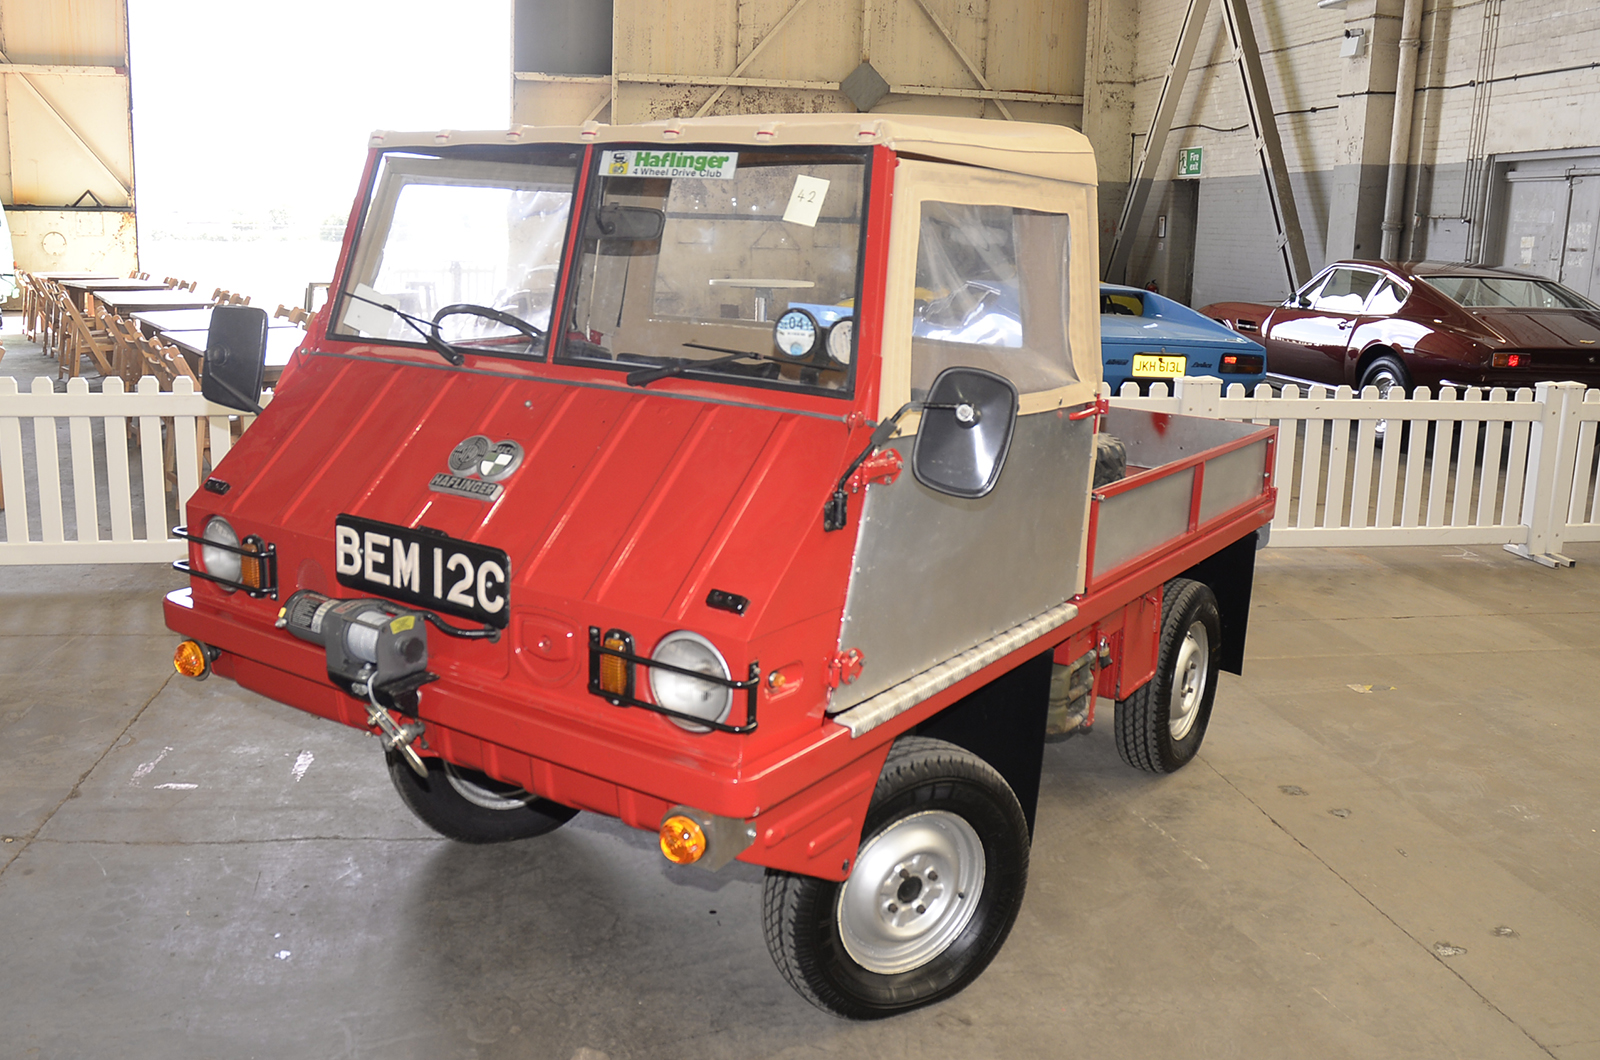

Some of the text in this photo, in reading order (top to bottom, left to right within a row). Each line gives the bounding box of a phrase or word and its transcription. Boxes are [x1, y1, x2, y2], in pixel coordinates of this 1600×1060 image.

[635, 152, 729, 171] Haflinger
[1190, 152, 1200, 161] Fire
[640, 168, 668, 176] Wheel
[671, 168, 697, 177] Drive
[699, 169, 722, 178] Club
[1189, 162, 1199, 171] exit
[797, 189, 817, 203] 42
[1135, 361, 1156, 372] JKH
[1159, 360, 1182, 373] 613L
[431, 474, 497, 495] HAFLINGER
[336, 525, 505, 614] BEM 12C
